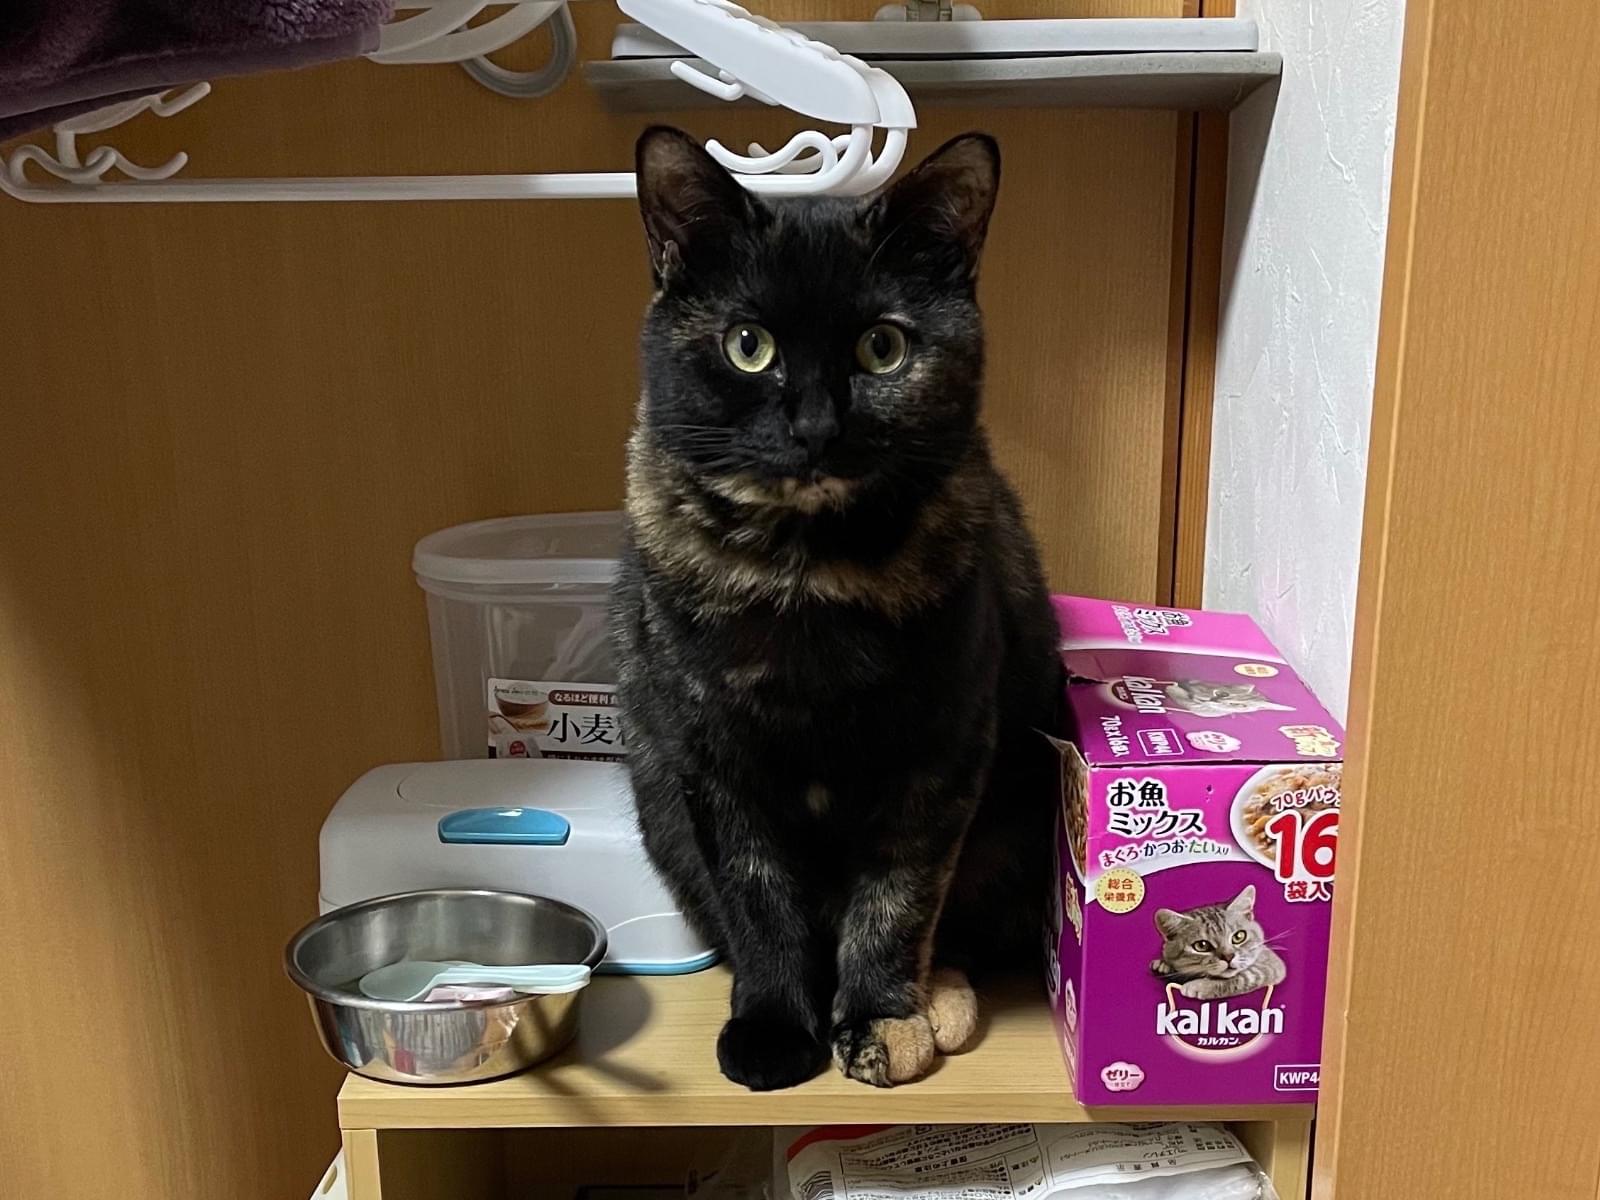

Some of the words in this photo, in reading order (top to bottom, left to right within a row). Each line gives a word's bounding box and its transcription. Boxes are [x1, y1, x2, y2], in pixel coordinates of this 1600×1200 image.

[1110, 780, 1166, 808] お魚
[1110, 810, 1204, 836] ミックス
[1270, 813, 1339, 879] 16
[1107, 878, 1134, 891] 総合
[1287, 881, 1331, 900] 袋入
[1103, 892, 1137, 903] 栄養食
[1156, 1002, 1209, 1035] kal
[1217, 1002, 1283, 1035] kan
[1196, 1037, 1240, 1046] カルカン
[1105, 1069, 1140, 1081] ゼリー
[1279, 1072, 1320, 1084] KWP4
